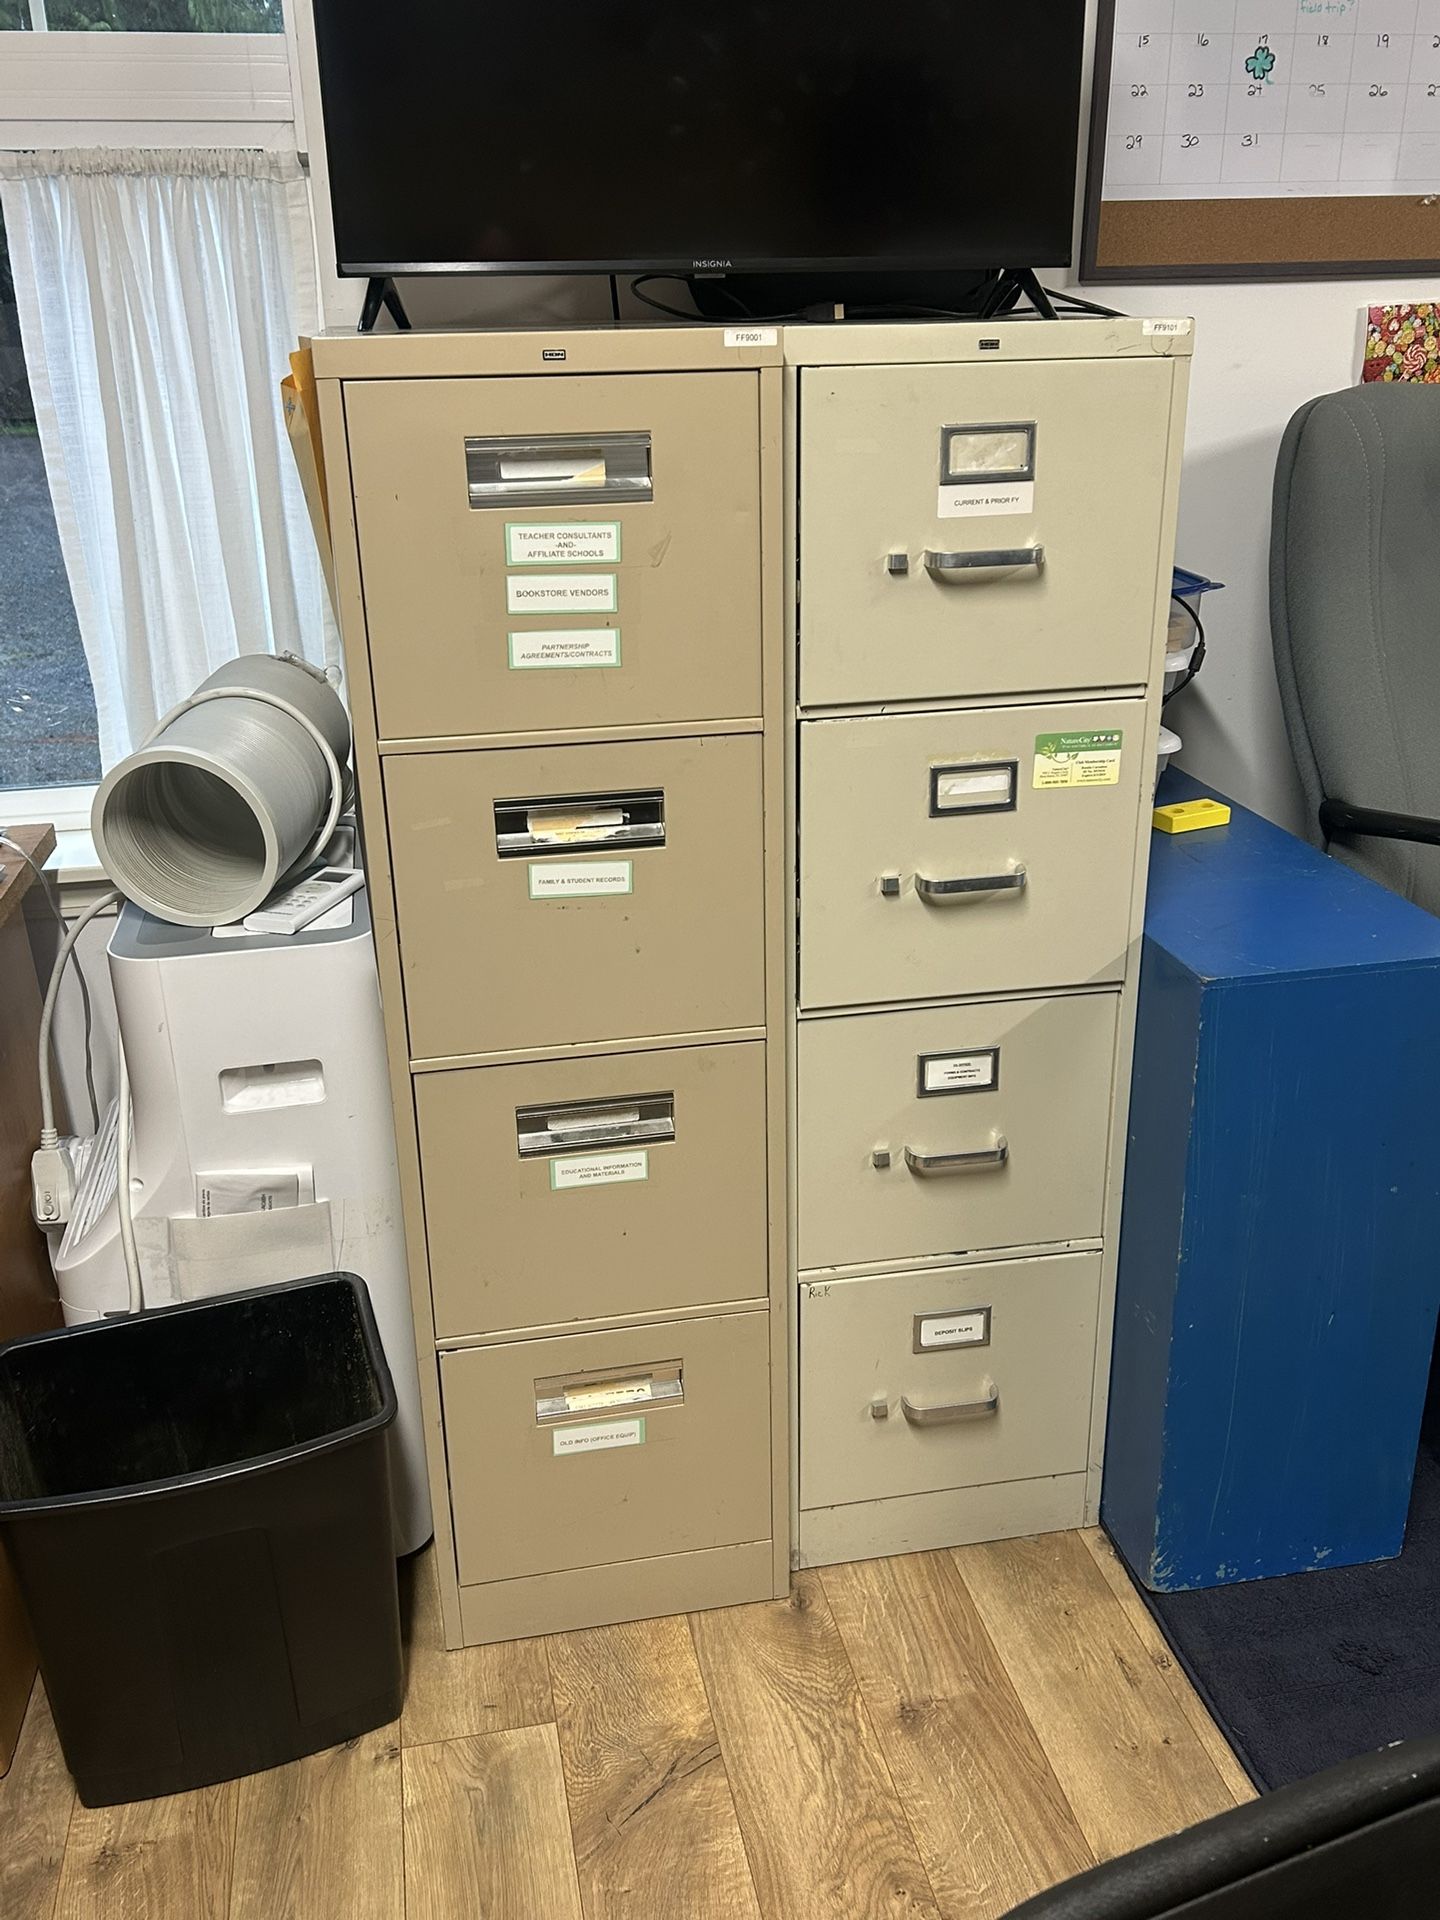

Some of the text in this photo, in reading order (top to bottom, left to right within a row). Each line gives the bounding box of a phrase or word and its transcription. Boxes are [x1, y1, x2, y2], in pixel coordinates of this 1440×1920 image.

[1300, 0, 1322, 13] field
[1138, 35, 1150, 48] 15
[1198, 33, 1209, 46] 16
[1259, 34, 1268, 44] 17
[1318, 35, 1329, 46] 18
[1377, 34, 1389, 48] 19
[1131, 84, 1148, 97] 22
[1188, 84, 1204, 97] 23
[1248, 84, 1262, 96] 24
[1309, 84, 1326, 97] 25
[1368, 84, 1388, 97] 26
[1126, 134, 1258, 149] 29 30 31
[693, 260, 732, 268] INSIGNIA
[736, 333, 762, 342] FF9001
[954, 499, 984, 507] CURRENT
[518, 532, 612, 540] TEACHER CONSULTANTS
[528, 550, 565, 558] AFFILIATE
[570, 589, 609, 597] VENDORS
[542, 643, 590, 651] PARTNERSHIP
[521, 650, 612, 659] AGREEMENTS/CONTRACTS
[561, 1162, 642, 1175] EDUCATIONAL INFORMATION
[593, 1170, 625, 1178] MATERIALS
[590, 1434, 614, 1443] (OFFICE
